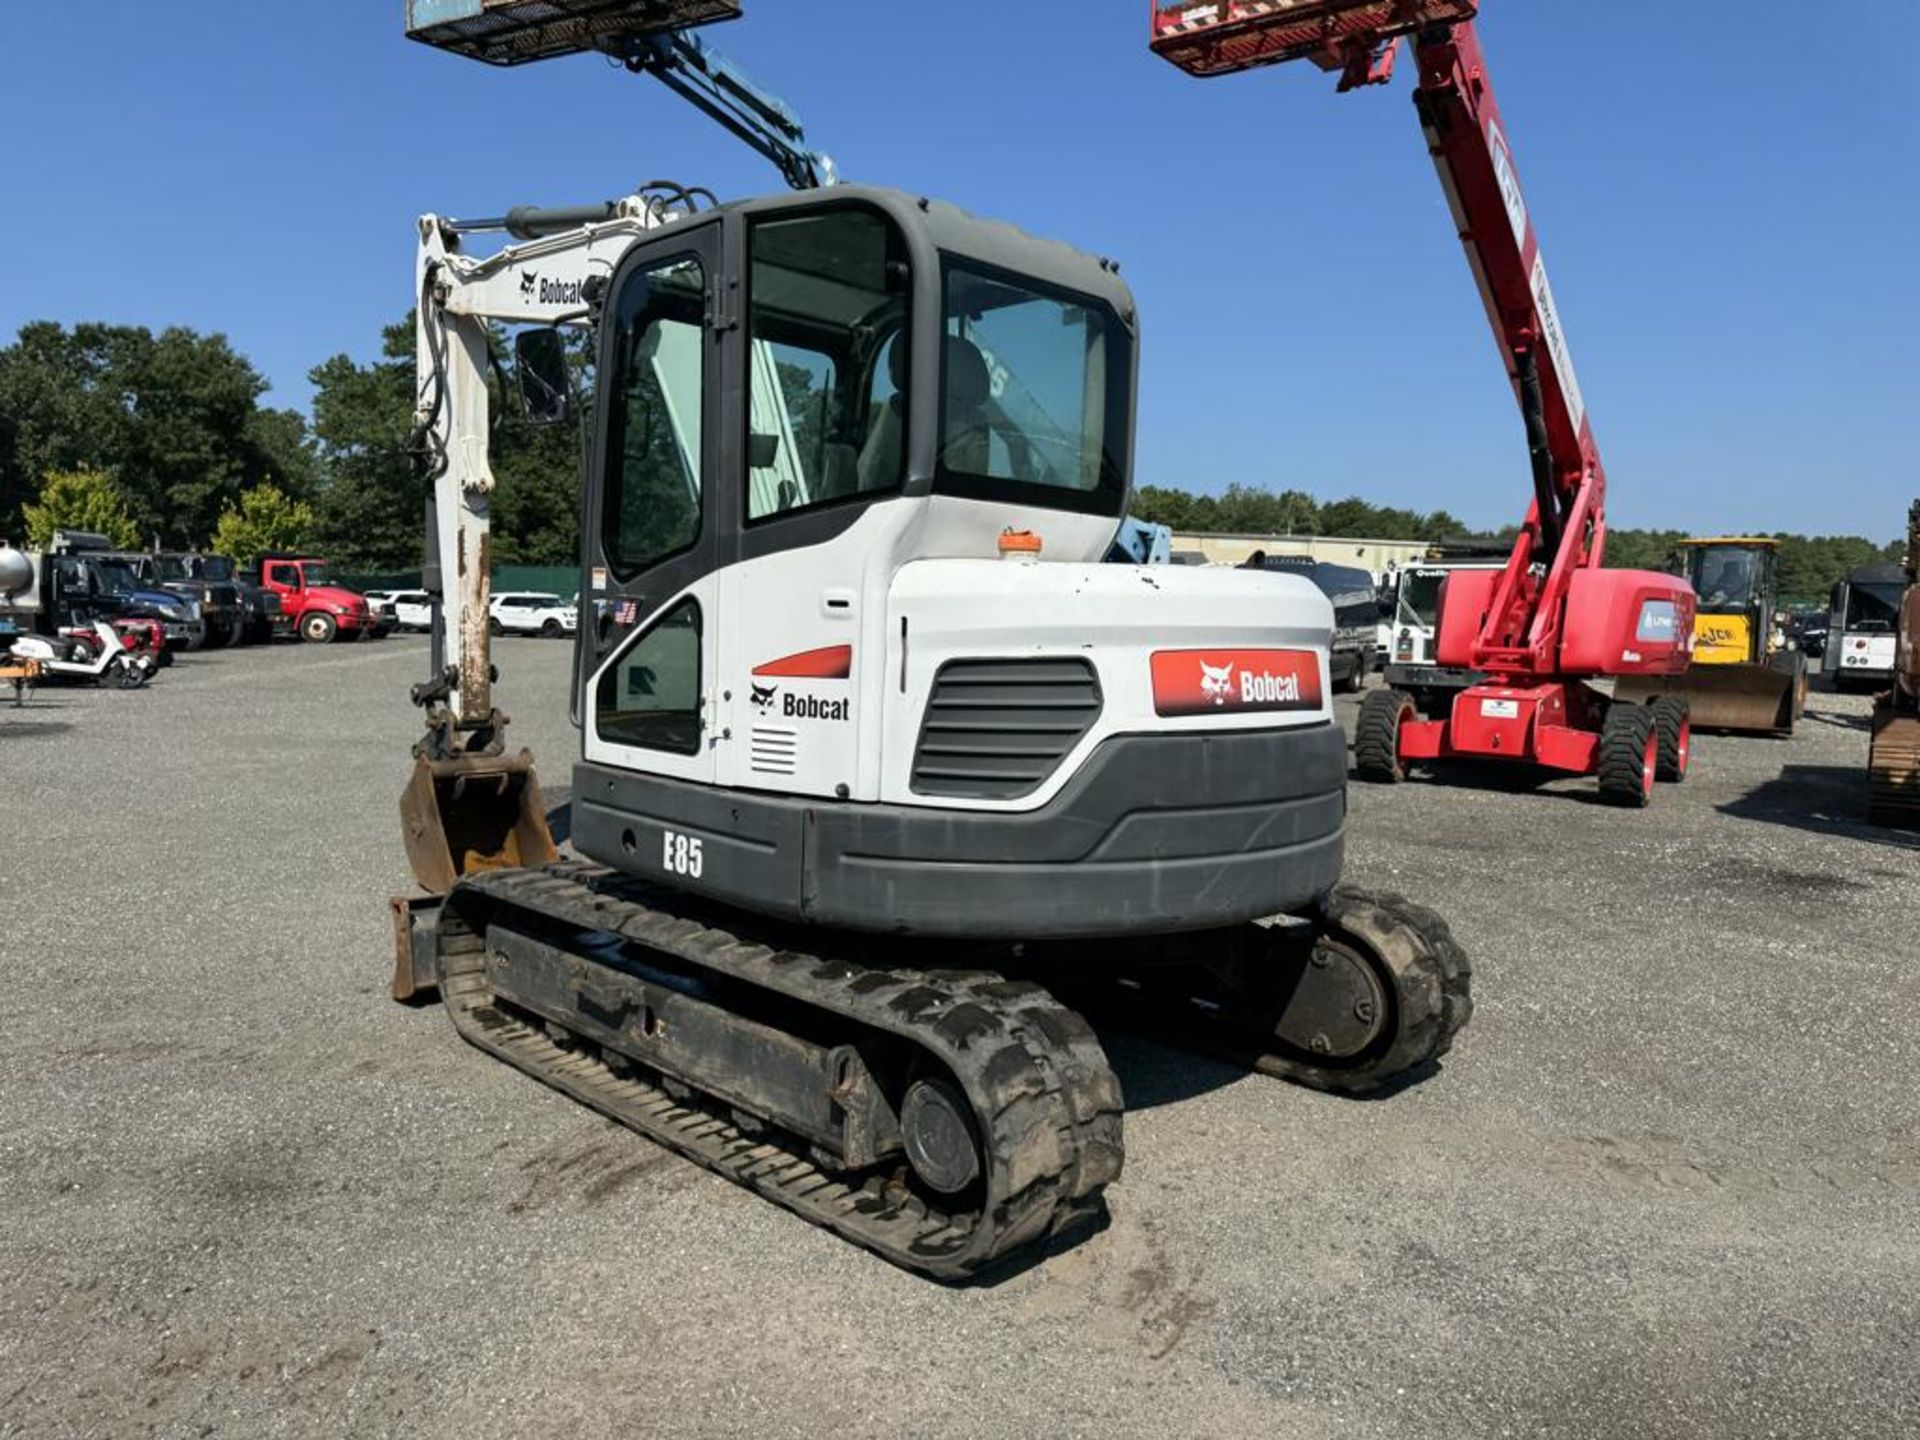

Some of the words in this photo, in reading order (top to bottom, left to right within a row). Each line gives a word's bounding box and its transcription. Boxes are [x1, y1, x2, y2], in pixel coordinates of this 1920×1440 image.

[539, 277, 582, 305] Bobcat
[1239, 670, 1300, 703] Bobcat
[783, 693, 850, 721] Bobcat
[663, 831, 703, 878] E85
